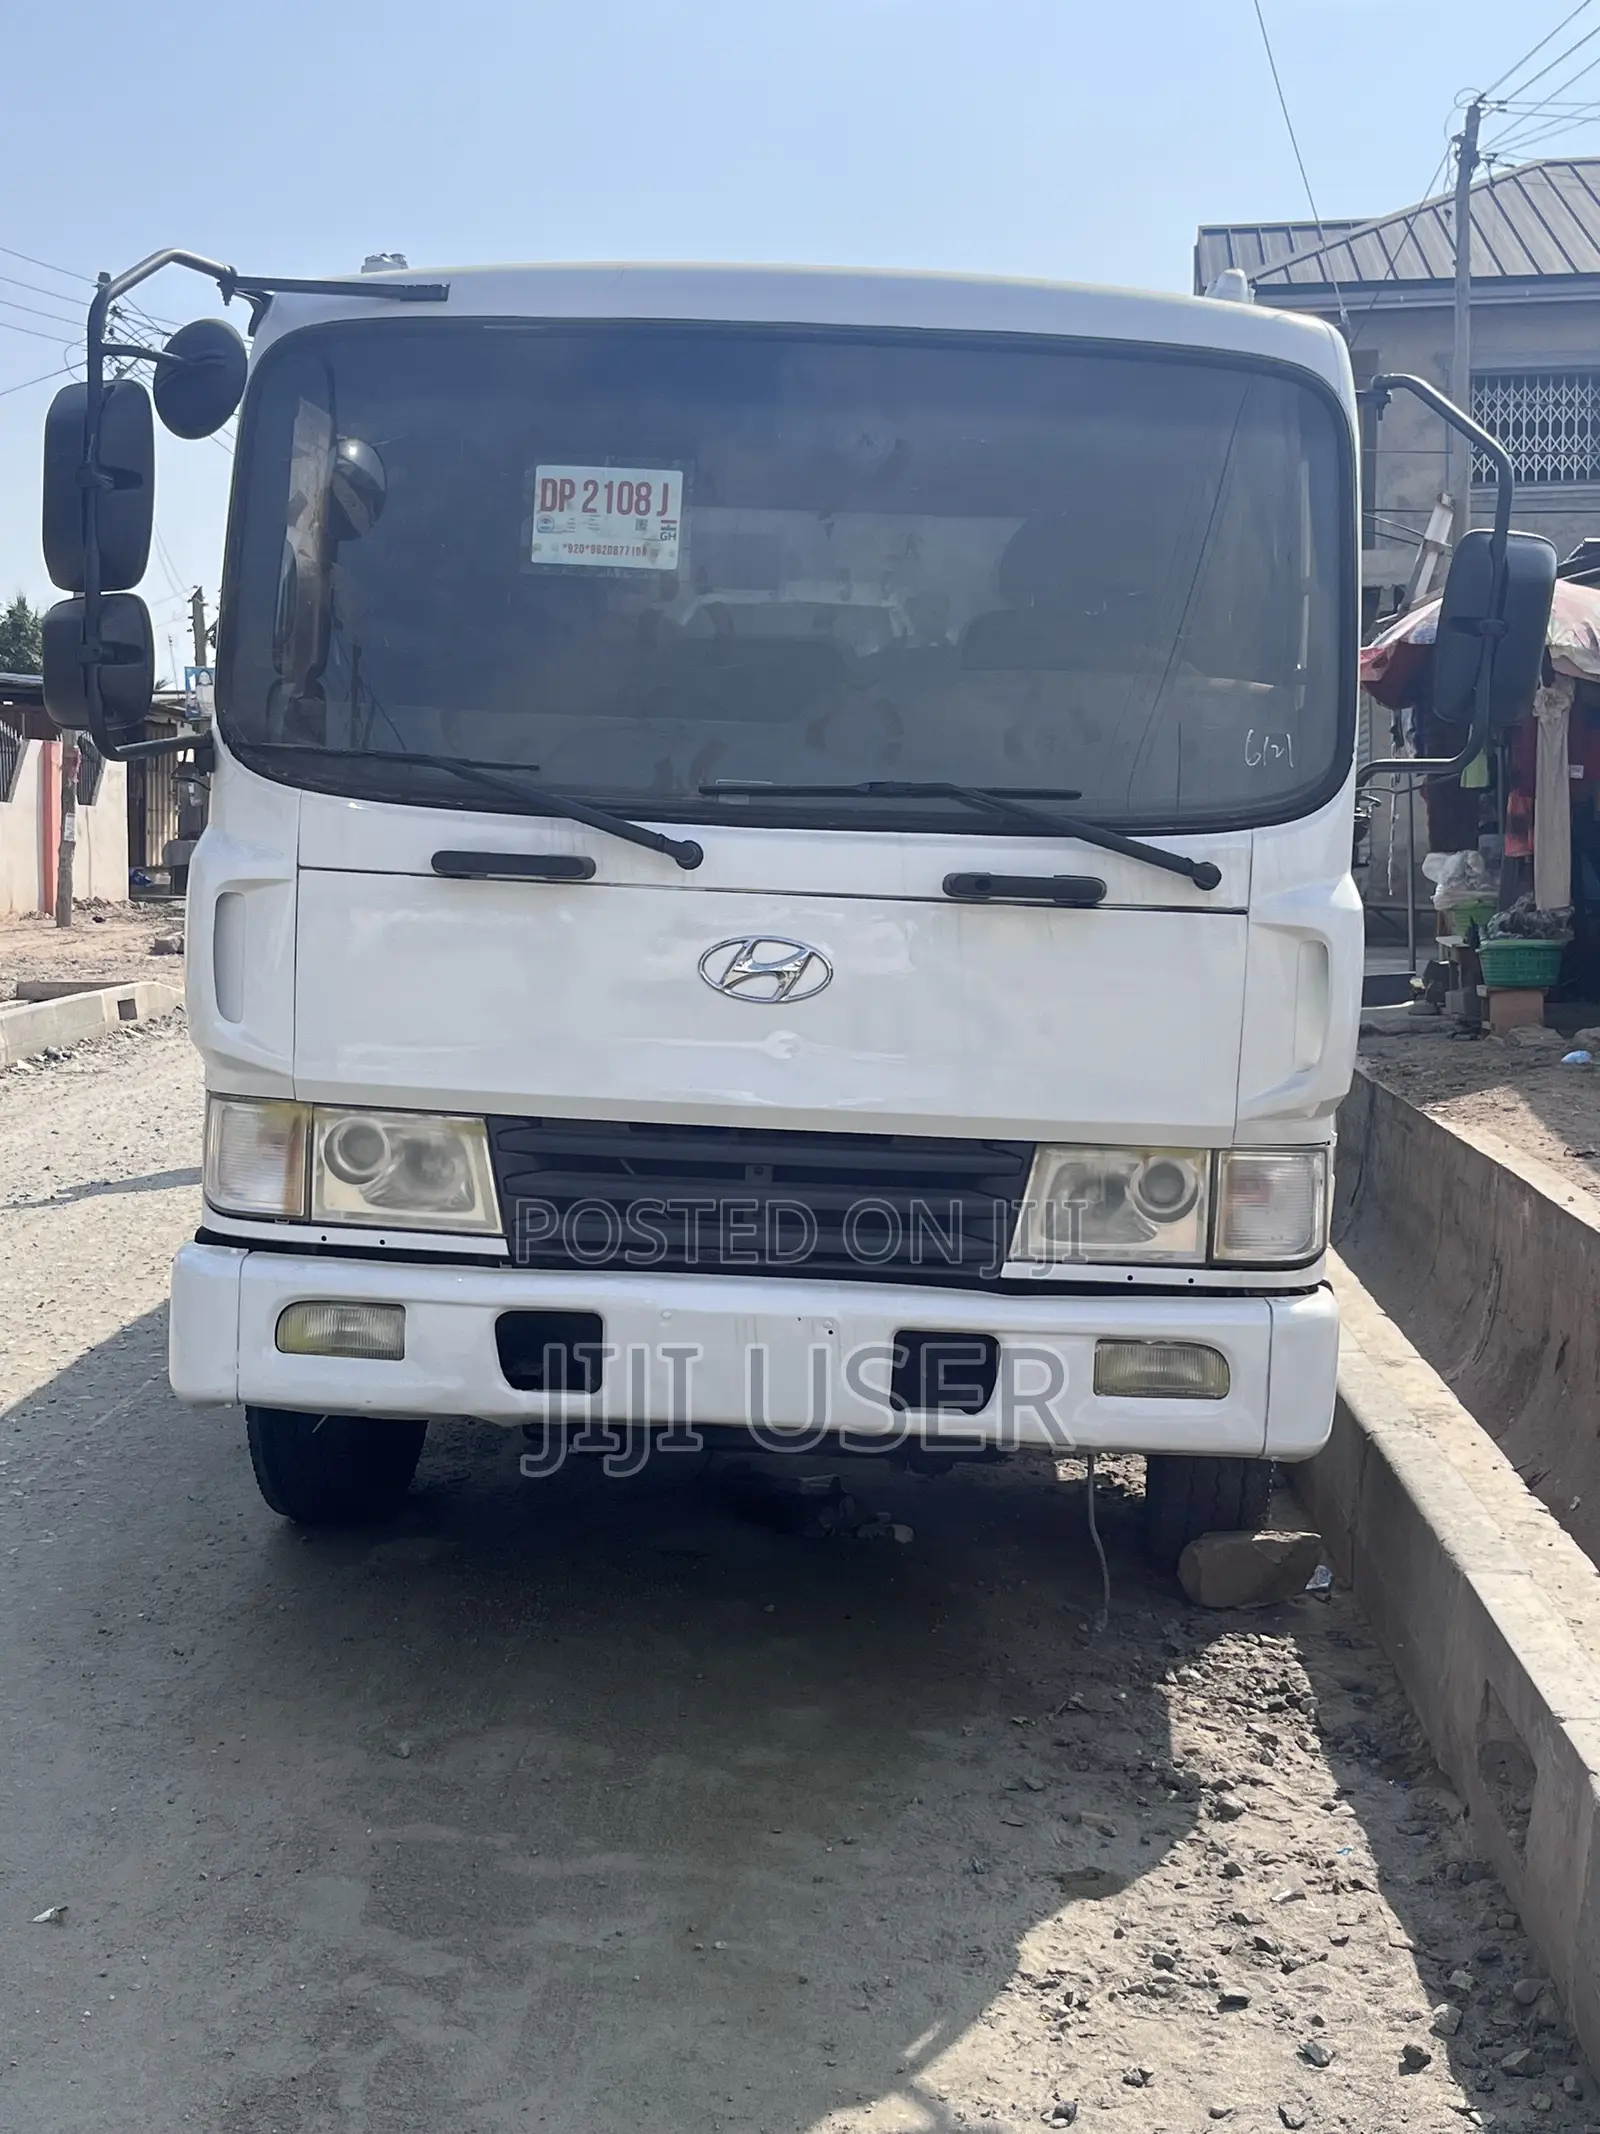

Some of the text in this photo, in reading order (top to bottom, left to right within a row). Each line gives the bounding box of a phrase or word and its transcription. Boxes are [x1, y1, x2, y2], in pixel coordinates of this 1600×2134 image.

[540, 478, 670, 517] DP 2108 J
[659, 532, 677, 541] GH
